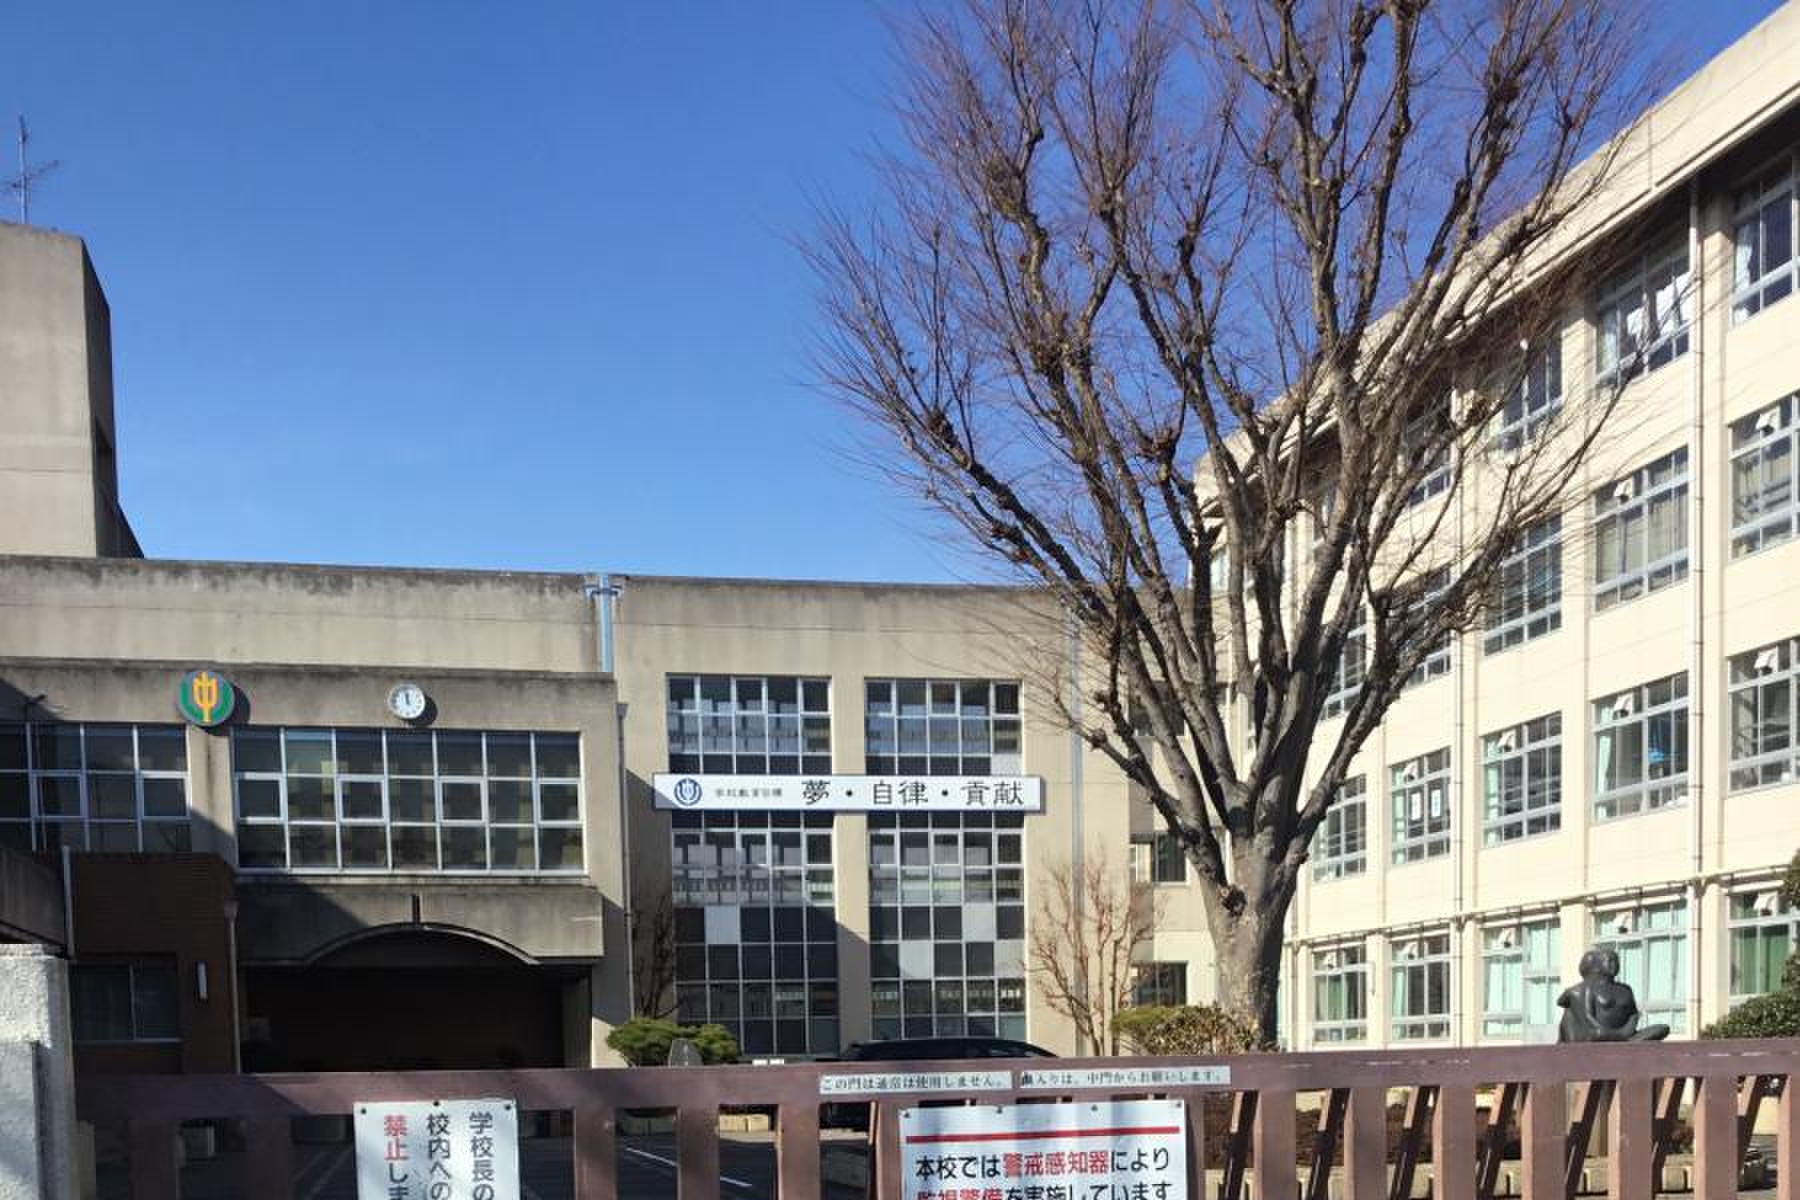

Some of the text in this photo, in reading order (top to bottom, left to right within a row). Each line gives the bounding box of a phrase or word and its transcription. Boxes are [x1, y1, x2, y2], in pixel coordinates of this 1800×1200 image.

[915, 1147, 1170, 1182] 本校では警戒感知器により
